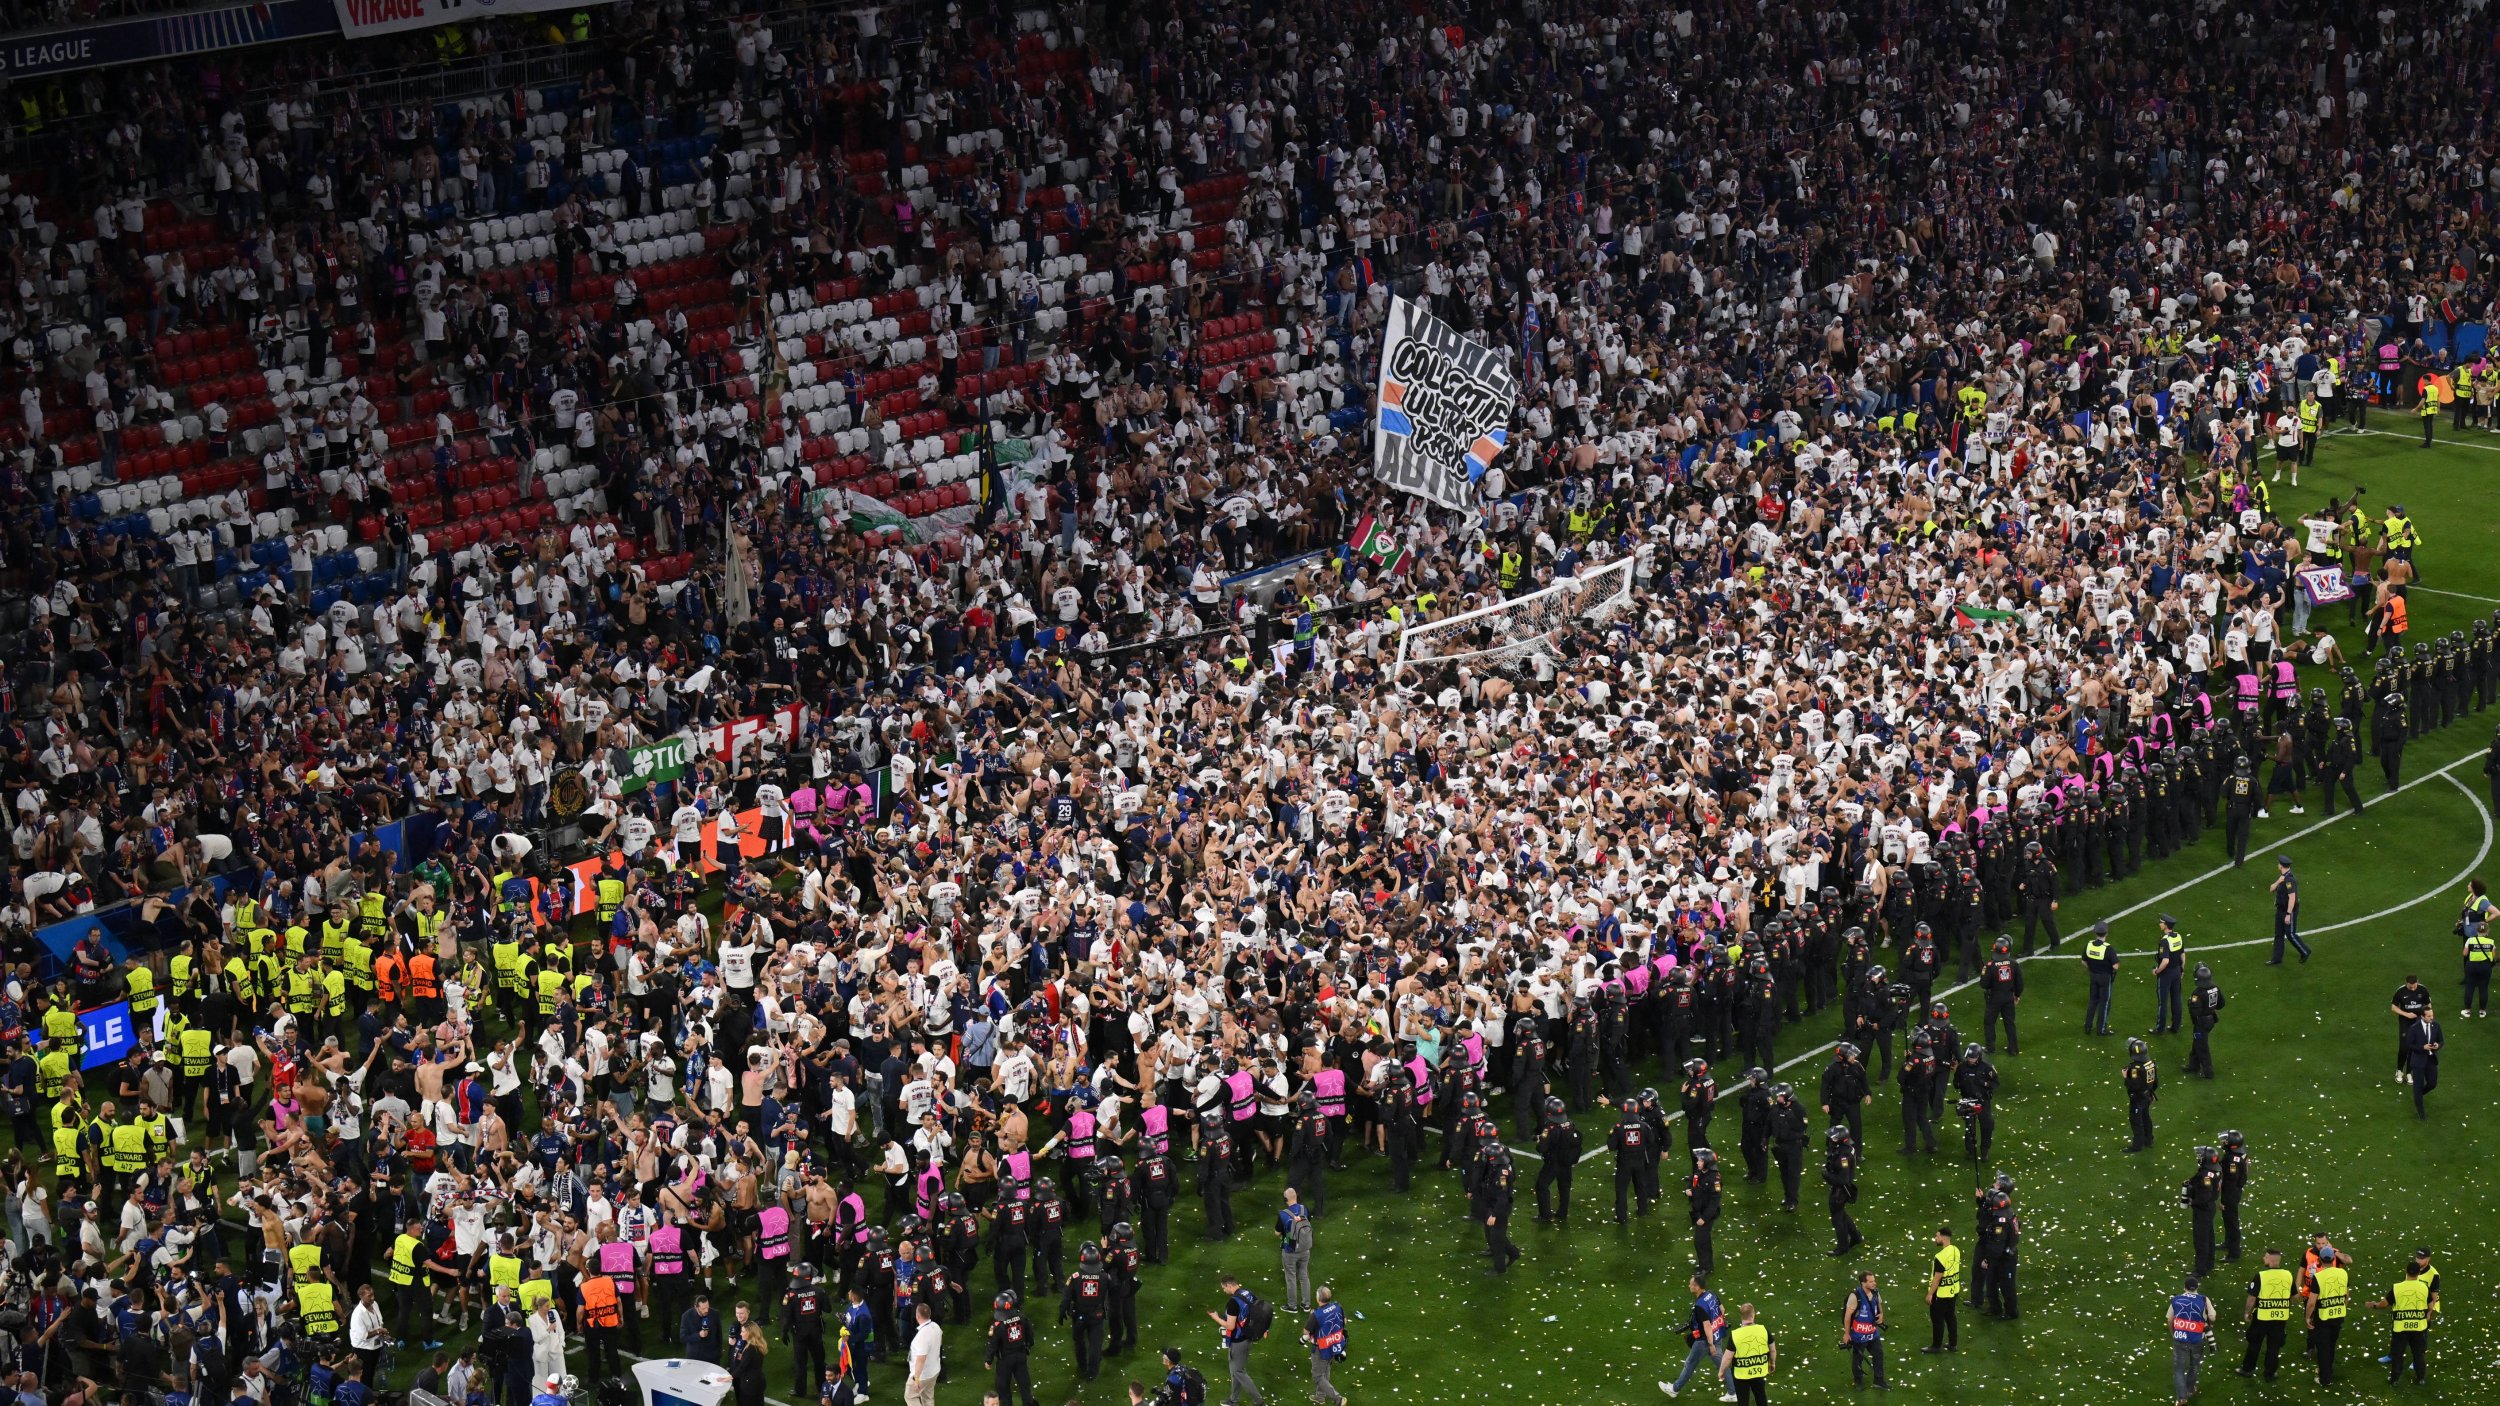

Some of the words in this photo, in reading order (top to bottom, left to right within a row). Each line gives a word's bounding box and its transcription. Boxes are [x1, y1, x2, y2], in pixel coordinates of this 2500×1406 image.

[15, 38, 92, 68] LEAGUE
[1058, 805, 1072, 817] 29
[78, 1017, 124, 1050] LE
[658, 1128, 670, 1142] 21
[1003, 1316, 1020, 1324] POLIZEI
[1748, 1368, 1763, 1376] 439
